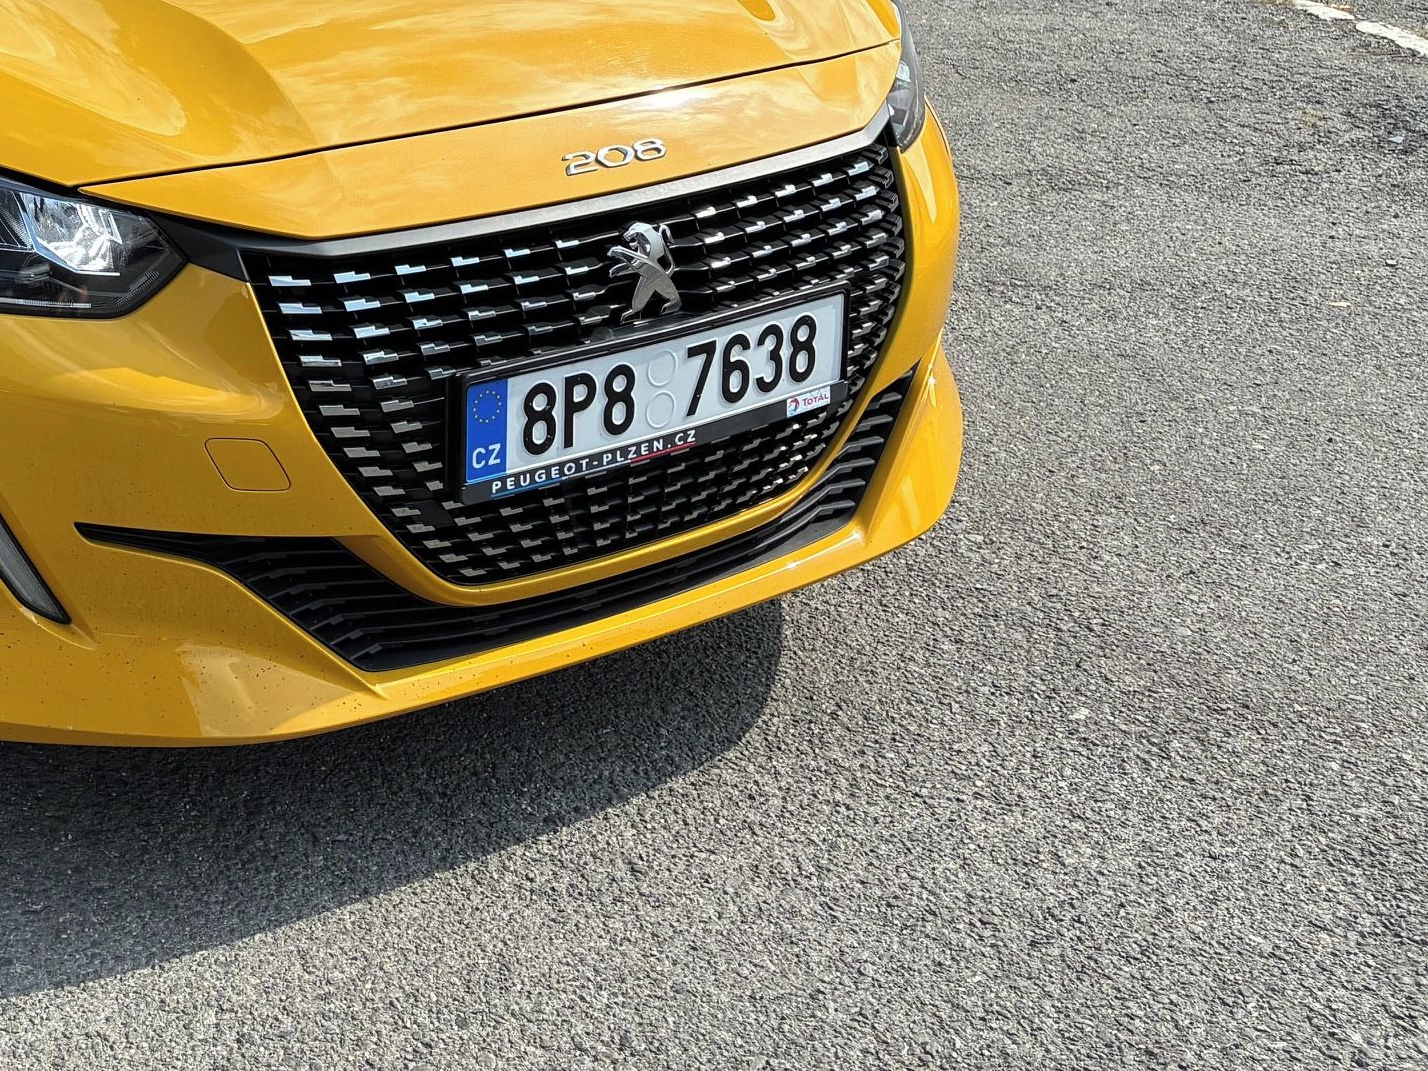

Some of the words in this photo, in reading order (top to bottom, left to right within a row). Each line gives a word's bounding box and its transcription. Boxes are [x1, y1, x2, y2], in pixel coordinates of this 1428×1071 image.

[562, 137, 667, 176] 208
[523, 363, 636, 456] 8P8
[687, 314, 818, 417] 7638
[472, 442, 501, 470] CZ
[491, 429, 697, 495] PEUGEOT-PLZEN.CZ
